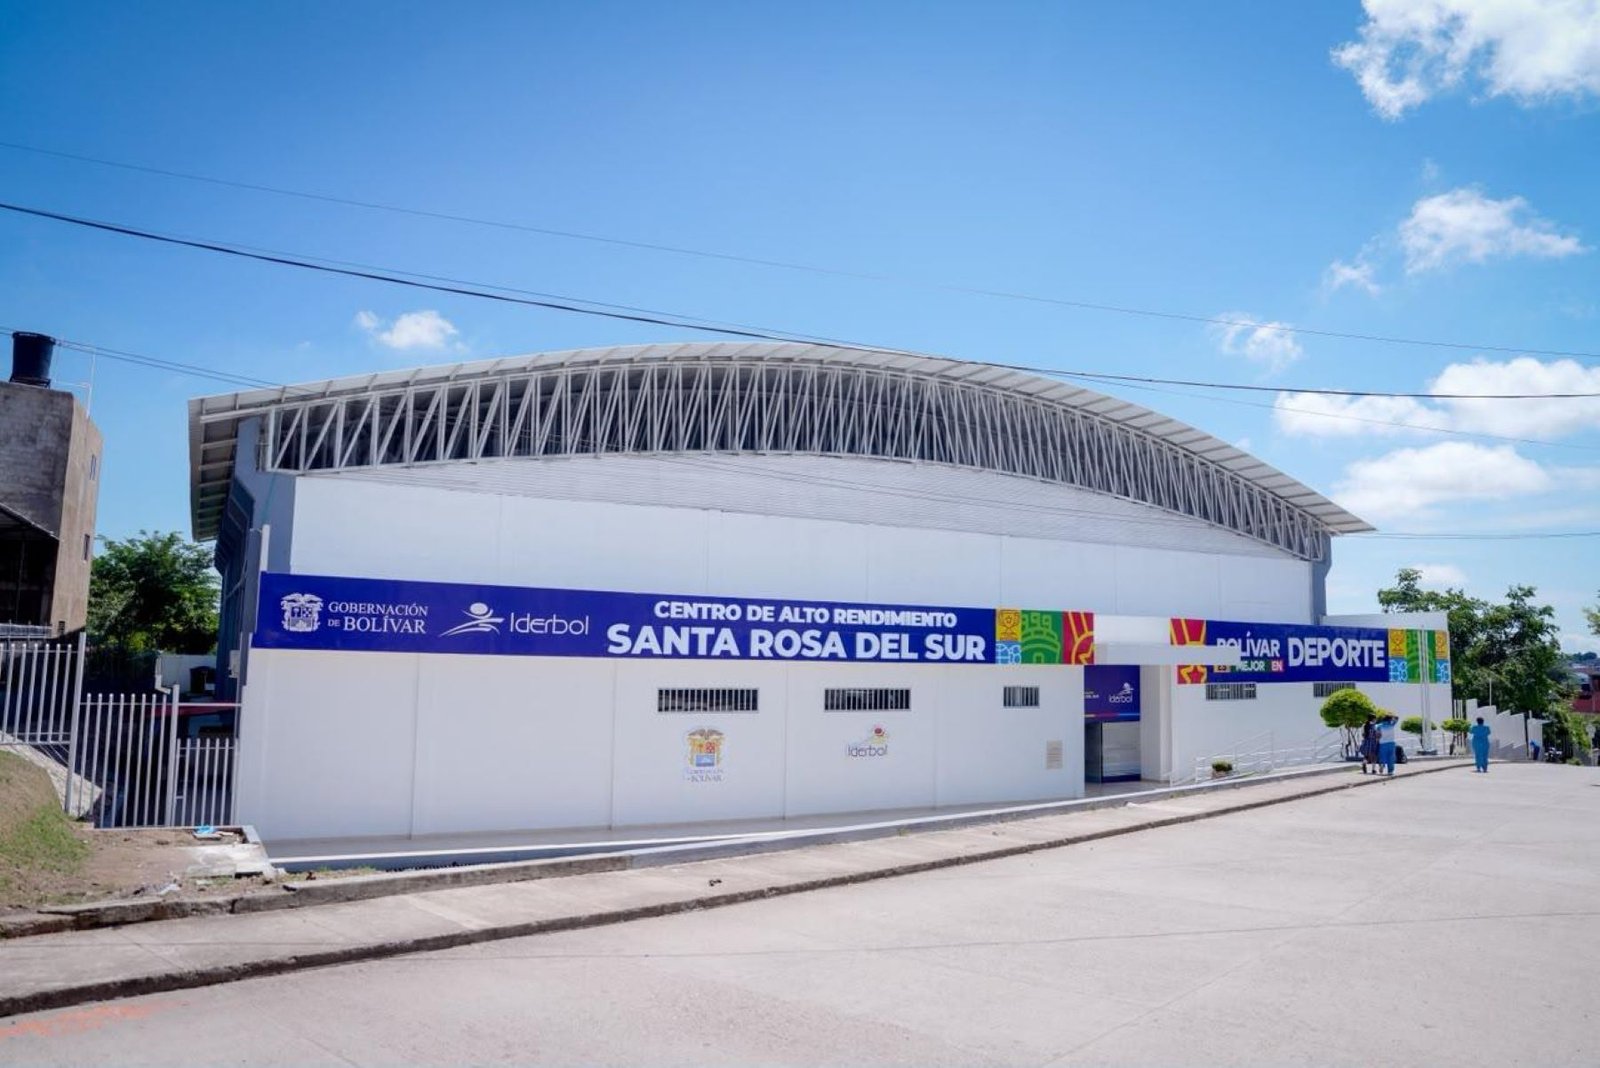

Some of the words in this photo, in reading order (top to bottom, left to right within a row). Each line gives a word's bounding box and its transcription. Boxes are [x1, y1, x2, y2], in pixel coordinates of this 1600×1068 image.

[328, 601, 429, 617] GOBERNACIÓN
[654, 600, 743, 621] CENTRO
[746, 604, 775, 622] DE
[778, 606, 831, 624] ALTO
[833, 608, 958, 628] RENDIMIENTO
[327, 618, 341, 627] DE
[343, 615, 427, 634] BOLÍVAR
[510, 612, 589, 635] Iderbol
[606, 622, 741, 657] SANTA
[749, 628, 848, 659] ROSA
[855, 632, 919, 660] DEL
[924, 633, 987, 661] SUR
[1287, 637, 1385, 667] DEPORTE
[1271, 660, 1283, 672] EN
